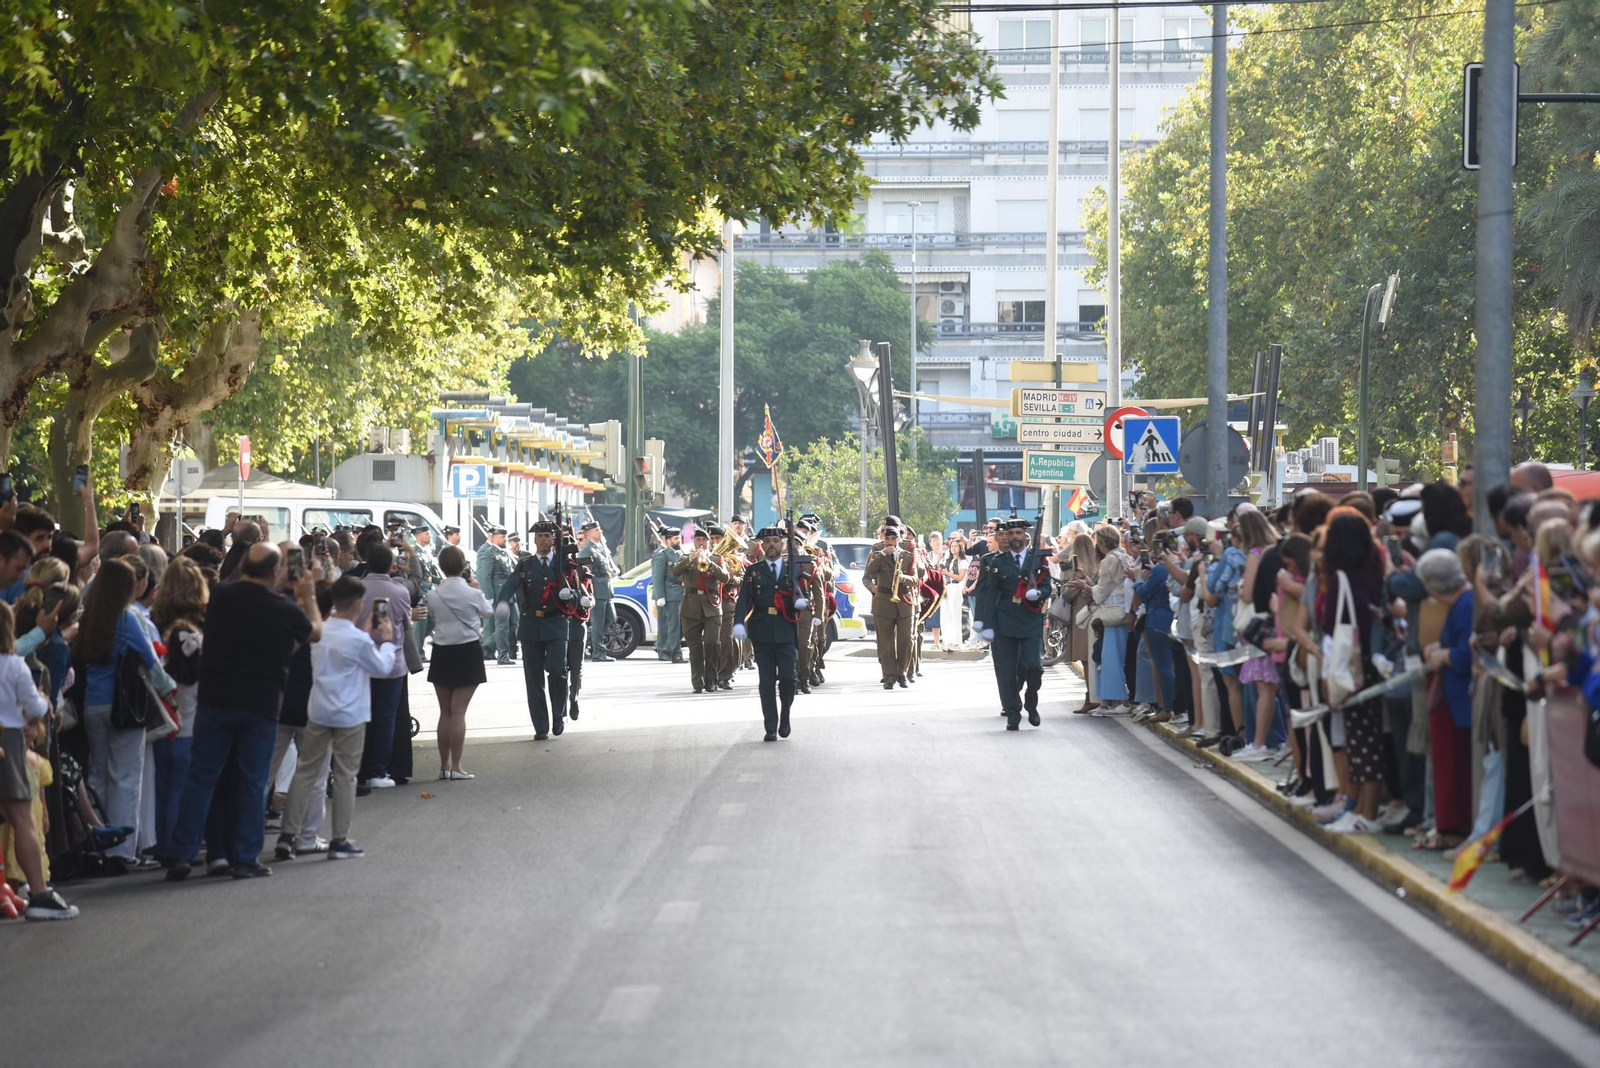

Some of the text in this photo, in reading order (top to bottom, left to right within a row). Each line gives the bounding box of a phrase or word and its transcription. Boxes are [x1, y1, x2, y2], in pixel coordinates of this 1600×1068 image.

[1023, 392, 1057, 402] MADRID
[1023, 403, 1057, 412] SEVILLA
[1022, 429, 1082, 438] centro ciudad
[1030, 467, 1064, 478] Argentina
[459, 468, 481, 495] P
